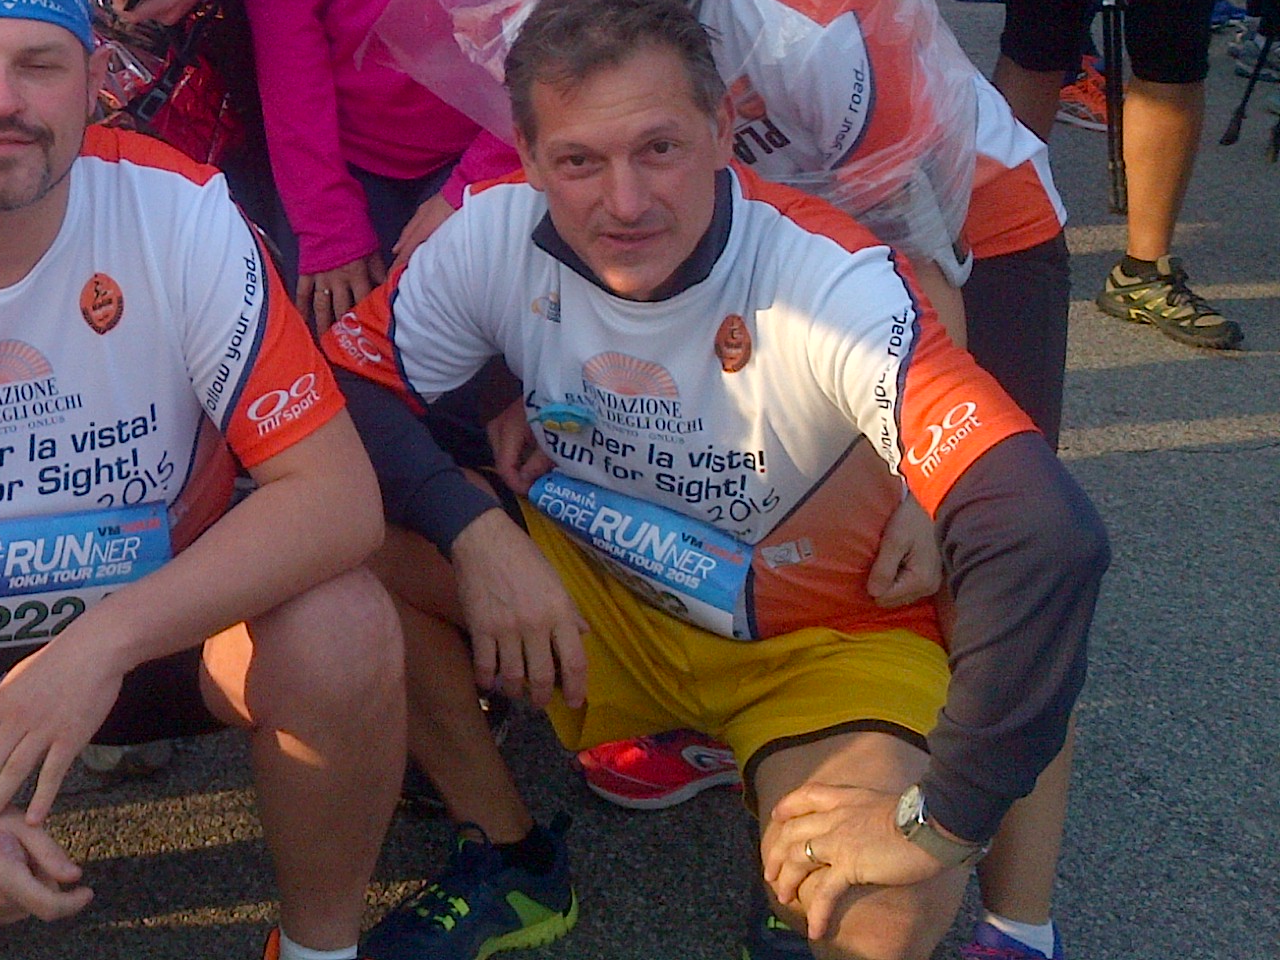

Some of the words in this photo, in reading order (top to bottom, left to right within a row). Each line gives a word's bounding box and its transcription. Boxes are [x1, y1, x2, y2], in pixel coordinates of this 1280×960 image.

[227, 316, 251, 361] your
[33, 392, 84, 416] OCCHI
[607, 411, 651, 429] DEGLI
[654, 417, 704, 435] OCCHI
[28, 433, 57, 463] la
[71, 403, 158, 455] vista!
[591, 427, 635, 458] per
[647, 443, 674, 469] la
[688, 444, 766, 473] vista!
[38, 448, 141, 504] Sight!
[544, 481, 596, 510] GARMIN
[604, 455, 643, 481] for
[655, 473, 747, 504] Sight!
[708, 487, 780, 523] 2015
[8, 575, 49, 589] 10KM
[52, 567, 93, 582] TOUR
[95, 562, 133, 578] 2015
[592, 536, 627, 557] 10KM
[628, 549, 664, 575] TOUR
[666, 568, 701, 589] 2015
